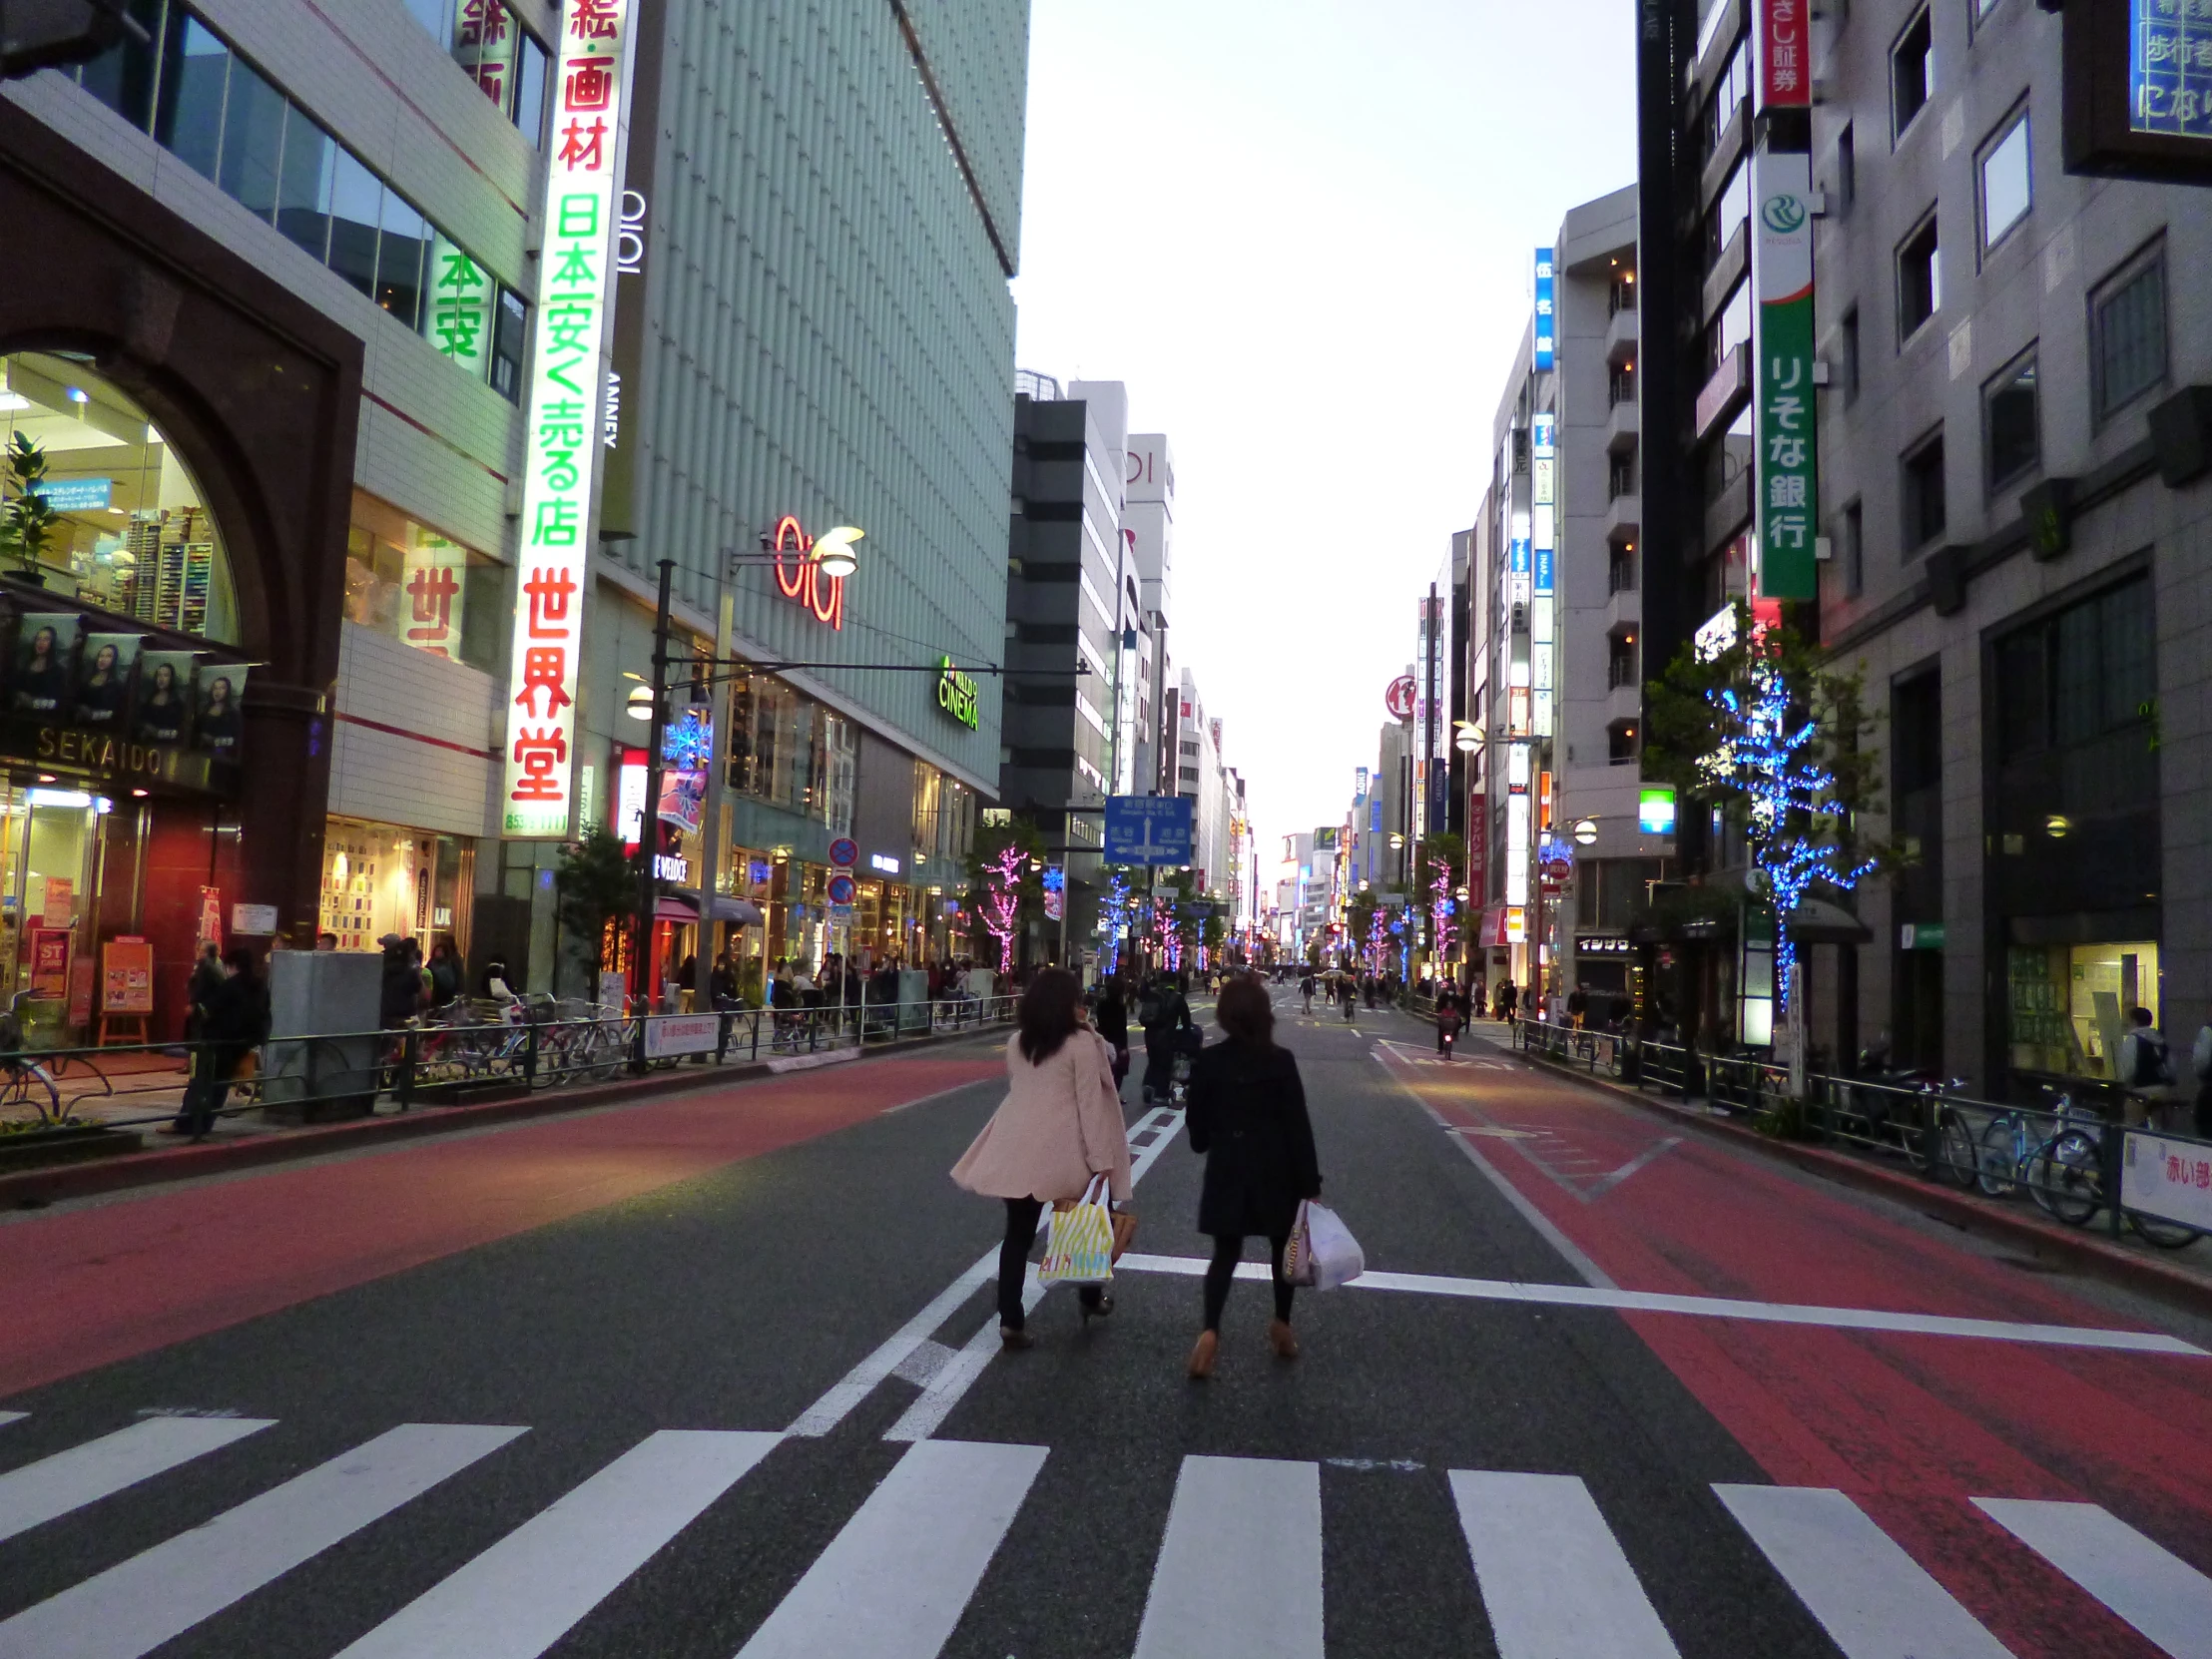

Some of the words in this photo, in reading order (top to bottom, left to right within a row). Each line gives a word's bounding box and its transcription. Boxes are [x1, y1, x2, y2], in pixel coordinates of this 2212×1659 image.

[531, 194, 600, 546] 日本一安く売る店
[1769, 357, 1807, 548] りそな銀行
[511, 567, 578, 801] 世界堂
[938, 678, 979, 732] CINEMA
[38, 727, 162, 776] SEKAIDO
[1357, 772, 1367, 796] AOKI
[661, 855, 688, 881] VELOCE
[40, 945, 65, 958] ST
